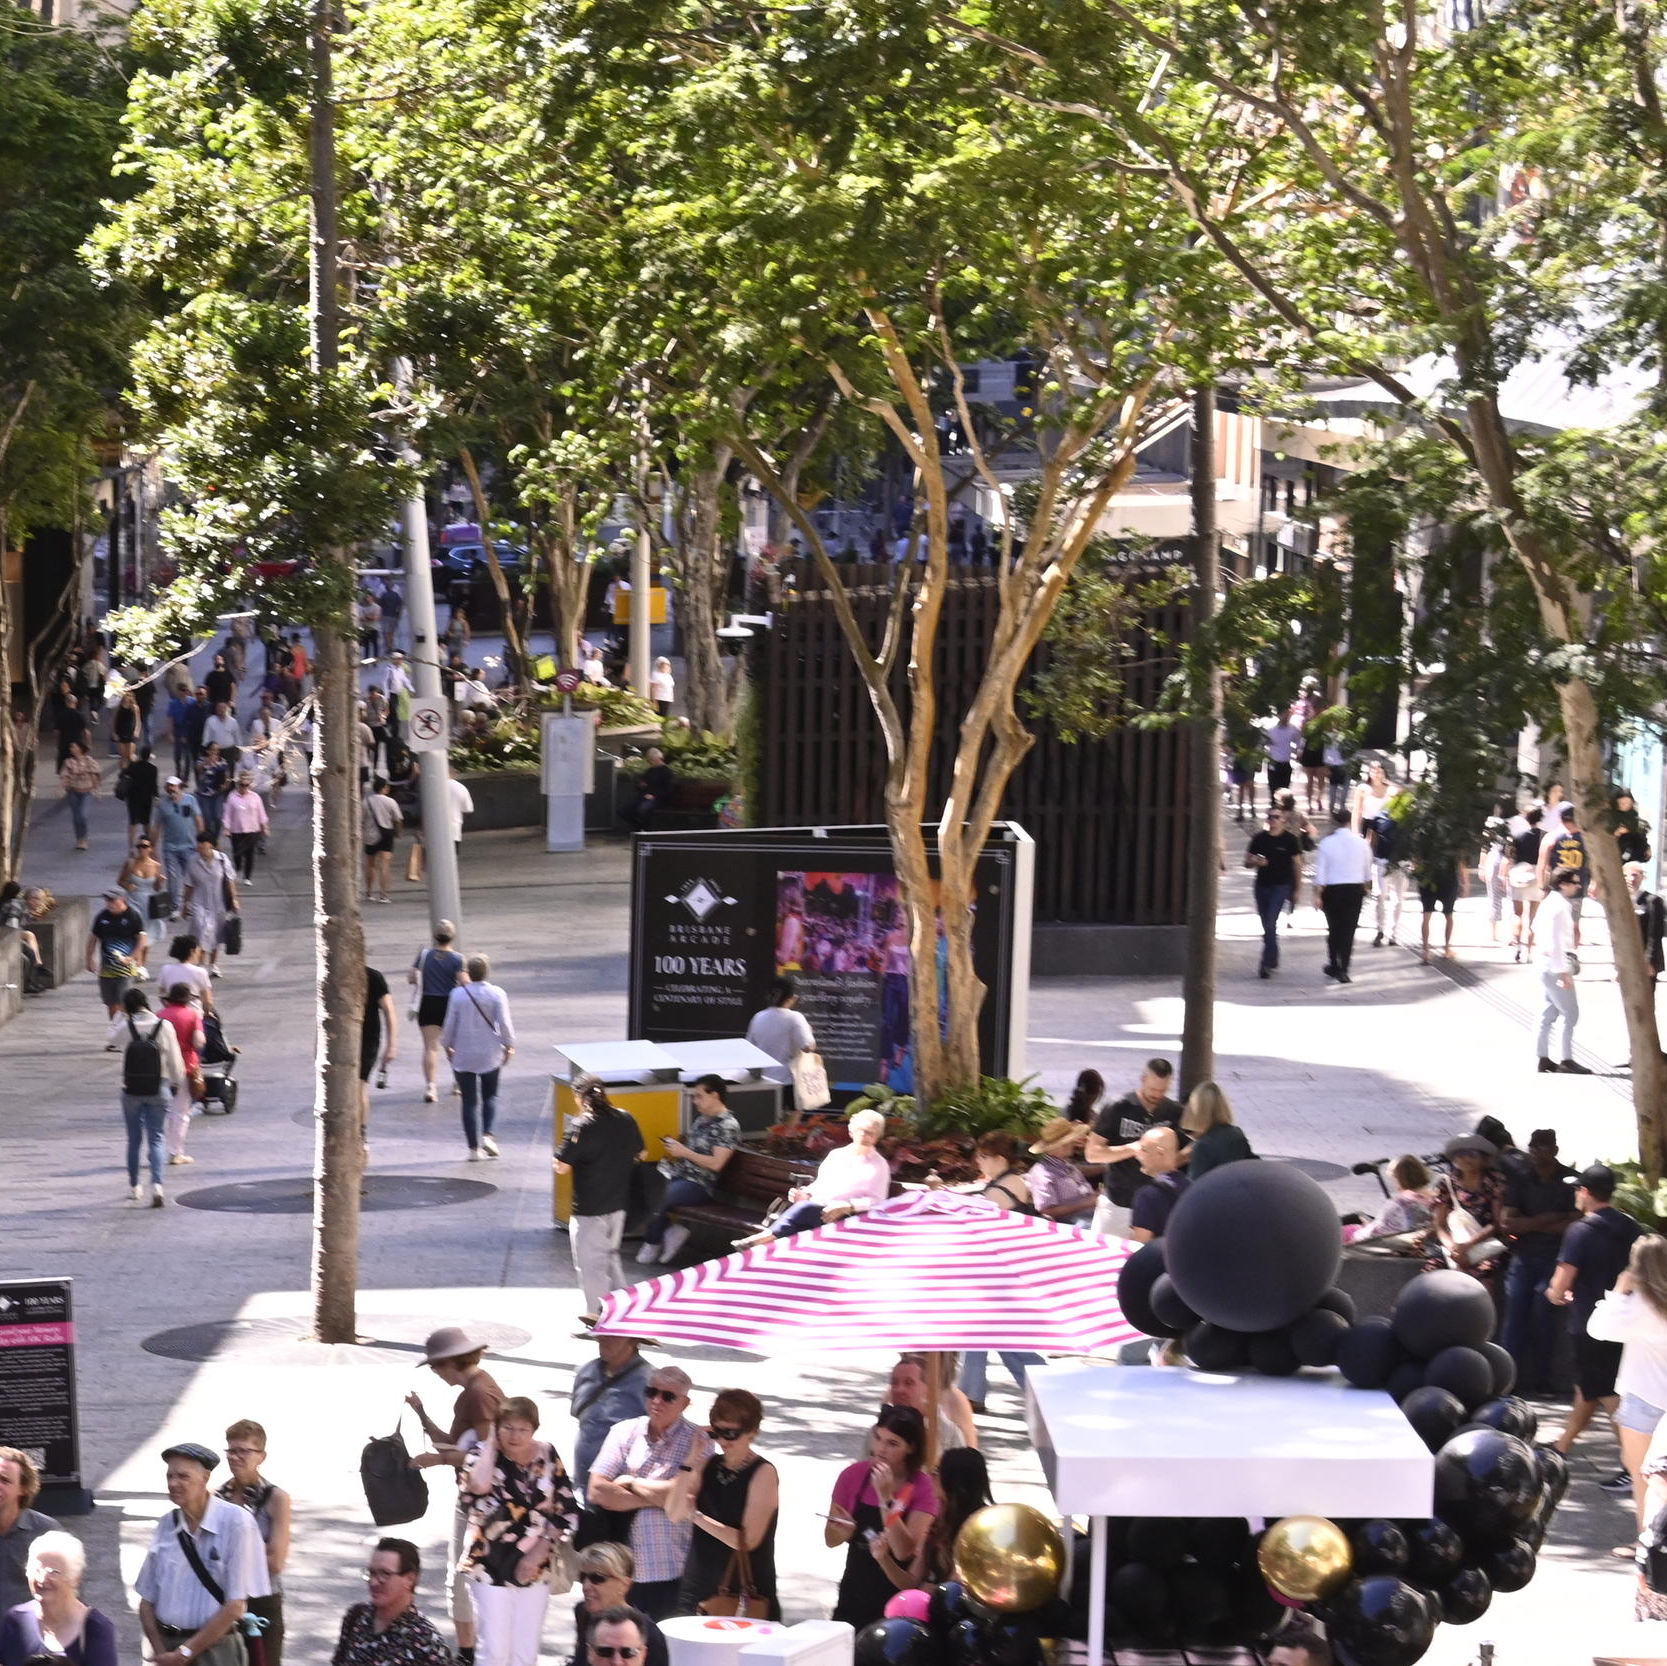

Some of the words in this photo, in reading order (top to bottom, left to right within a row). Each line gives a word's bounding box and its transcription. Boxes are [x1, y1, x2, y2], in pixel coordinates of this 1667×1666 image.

[1556, 849, 1584, 868] 30
[668, 924, 732, 935] BRISBANE
[668, 935, 731, 945] ARCADE
[654, 955, 685, 975] 100
[688, 957, 747, 977] YEARS
